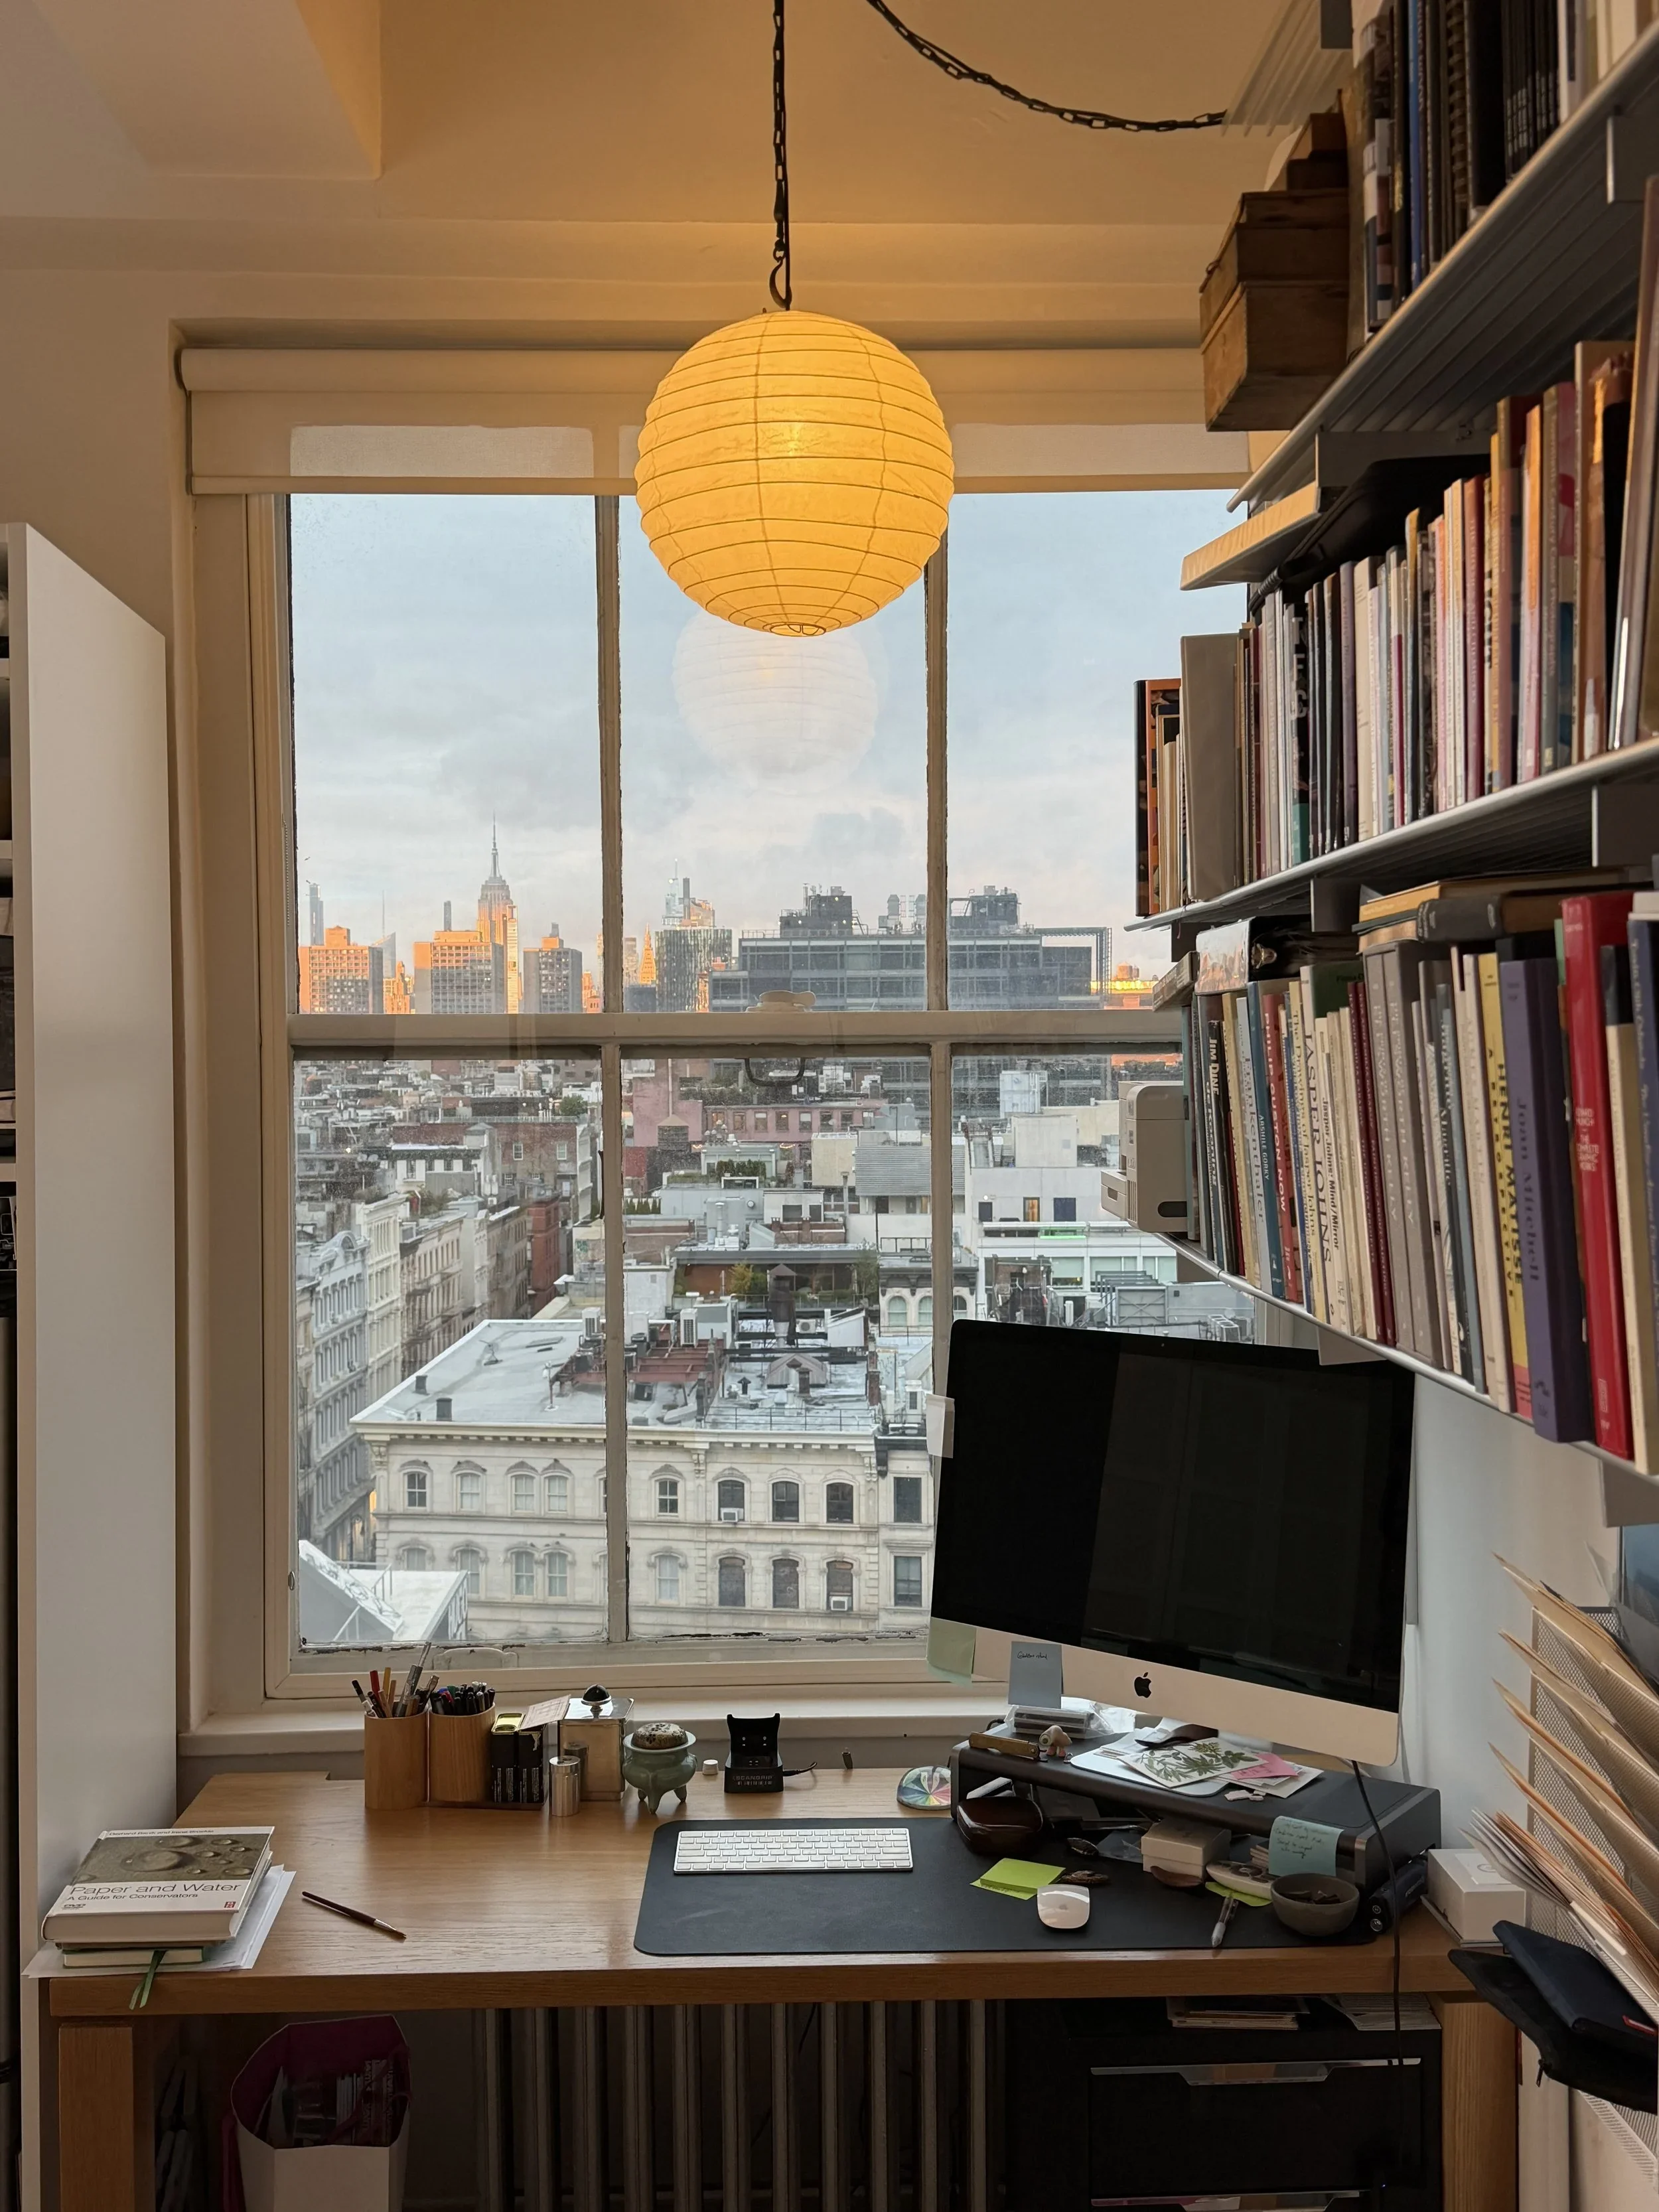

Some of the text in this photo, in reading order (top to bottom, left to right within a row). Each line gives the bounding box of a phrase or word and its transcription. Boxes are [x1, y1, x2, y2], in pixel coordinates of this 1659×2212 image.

[1264, 1013, 1285, 1211] PHILIP GUSTON NOW
[1295, 1045, 1305, 1118] Drawings
[1244, 1057, 1263, 1222] Frankenthaler
[1301, 1123, 1309, 1140] of
[1303, 1143, 1312, 1189] Jasper
[1304, 1033, 1331, 1262] JASPER JOHNS
[1386, 1154, 1397, 1220] KELLY
[1402, 1155, 1413, 1224] KELLY
[1490, 1082, 1514, 1299] RETROSPECTIVE
[1496, 1063, 1524, 1284] HENRI MATISSE
[1516, 1098, 1540, 1281] Joan Mitchell
[1307, 1195, 1317, 1236] Johns
[1328, 1180, 1340, 1249] Mind/Mirror
[70, 1883, 242, 1895] Paper and Water
